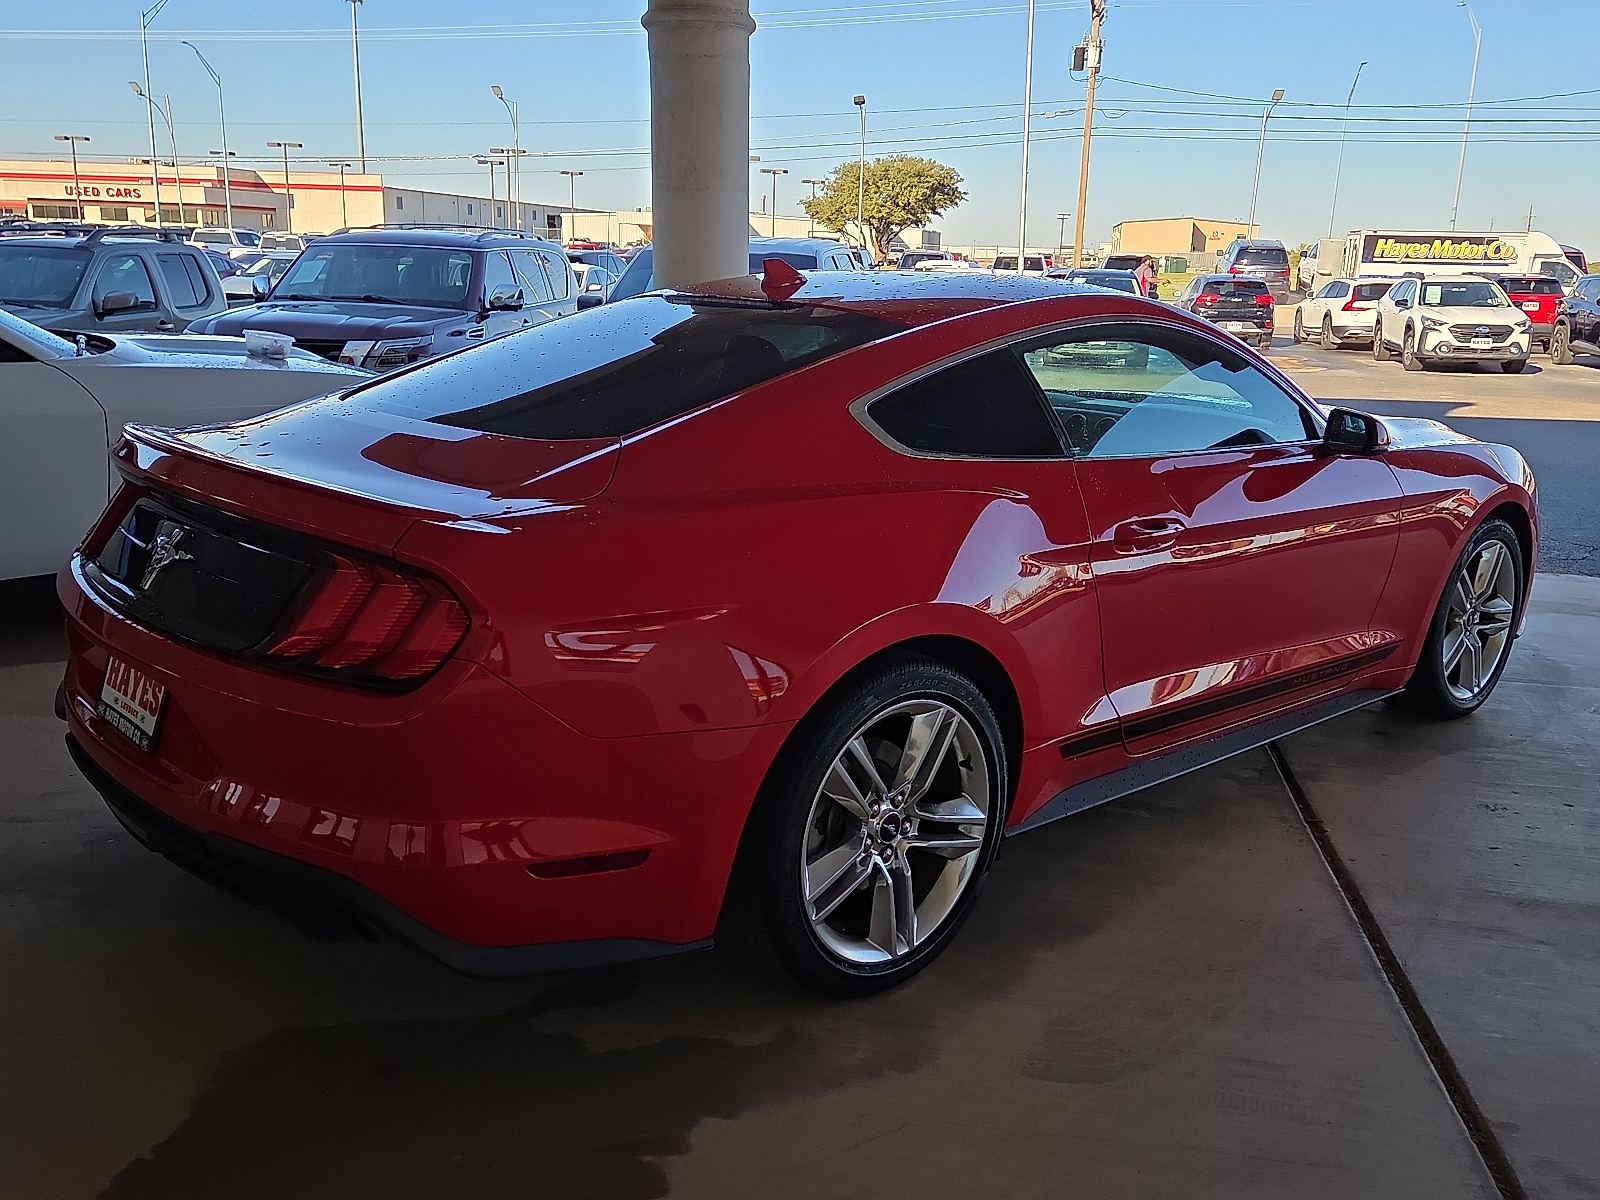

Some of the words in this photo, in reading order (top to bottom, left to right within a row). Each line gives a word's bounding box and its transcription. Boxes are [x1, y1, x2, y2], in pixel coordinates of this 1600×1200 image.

[64, 185, 101, 197] USED
[106, 187, 141, 198] CARS
[1373, 238, 1431, 263] Hayes
[1429, 239, 1487, 260] Motor
[1487, 240, 1518, 260] Co.
[1291, 662, 1350, 686] MUSTANG
[105, 656, 163, 718] HAYES
